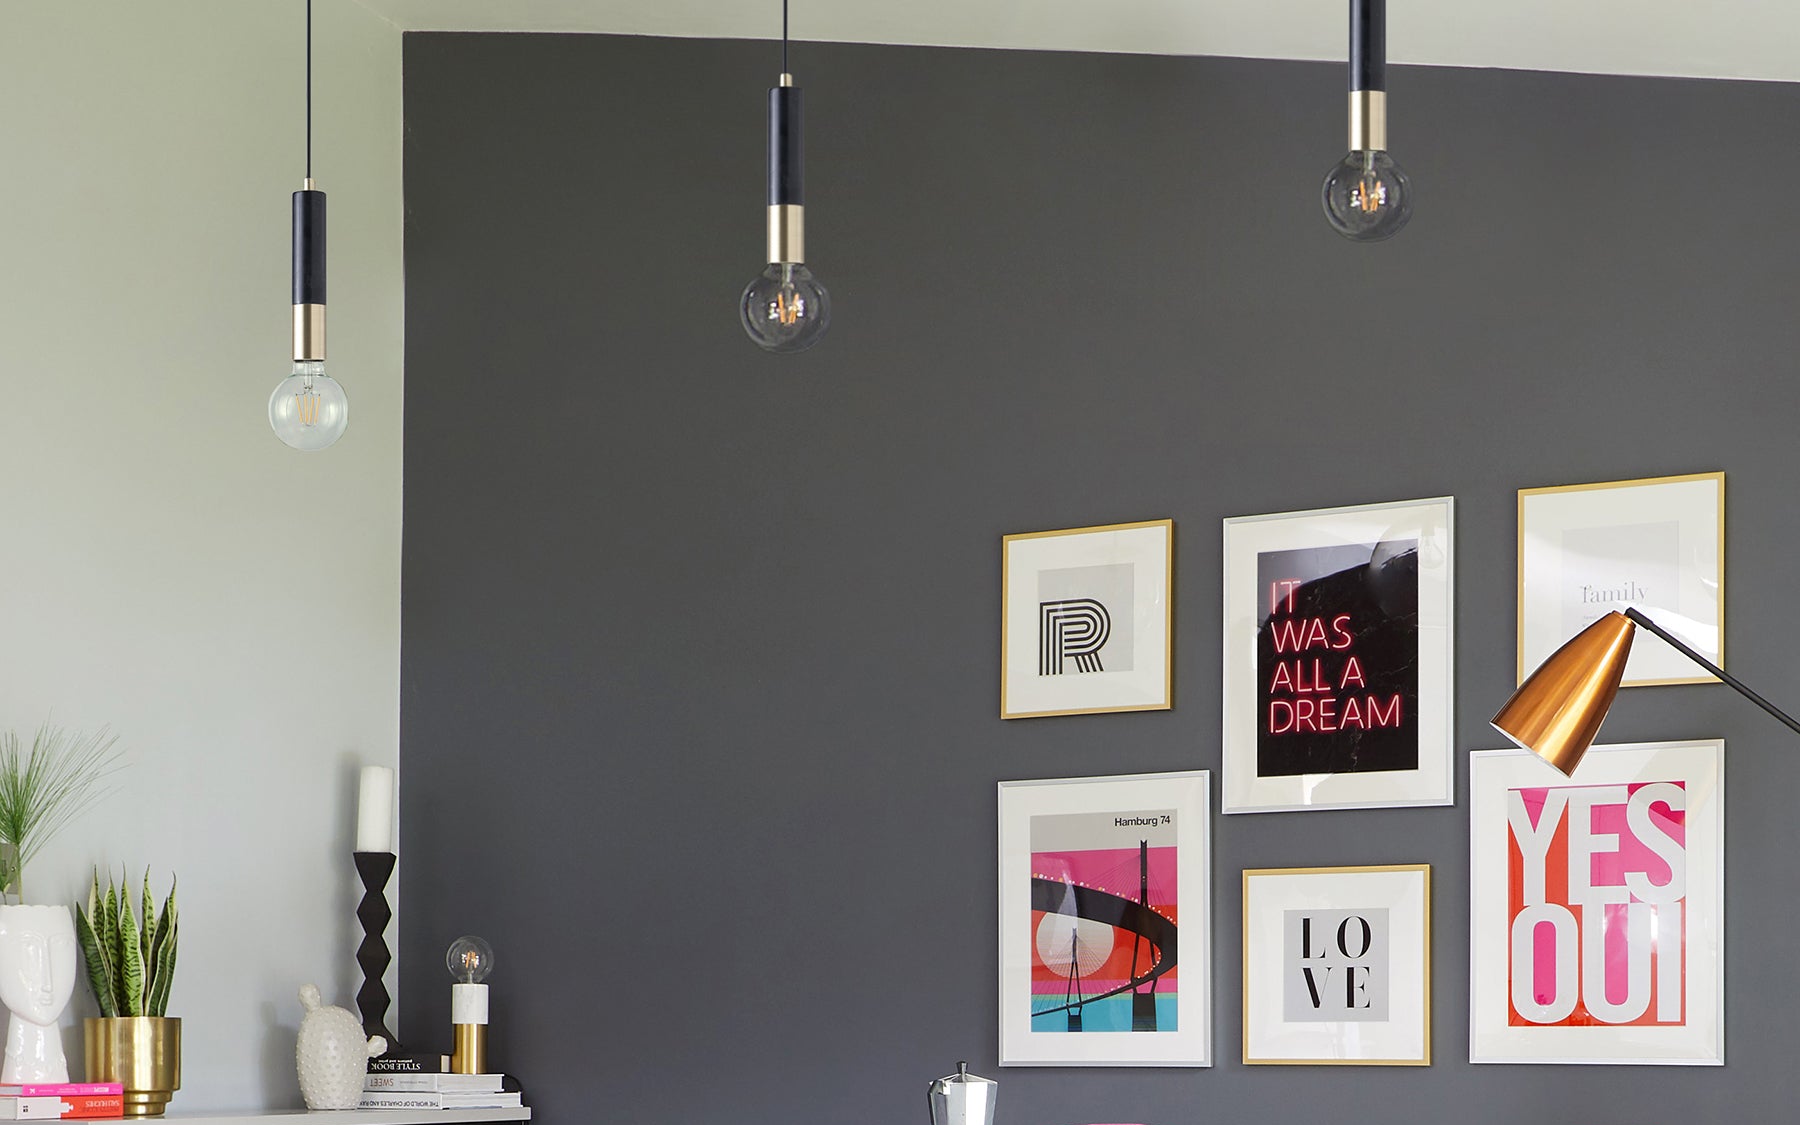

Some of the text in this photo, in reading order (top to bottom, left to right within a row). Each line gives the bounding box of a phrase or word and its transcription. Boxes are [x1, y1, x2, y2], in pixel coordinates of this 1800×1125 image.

[1271, 580, 1301, 615] IT
[1581, 580, 1649, 605] family
[1040, 598, 1110, 676] R
[1270, 616, 1351, 653] WAS
[1270, 656, 1365, 694] ALL A
[1270, 694, 1400, 734] DREAM
[1114, 815, 1171, 828] Hamburg 74
[1507, 782, 1686, 905] YES
[1300, 915, 1372, 959] LO
[1511, 902, 1682, 1024] OUI
[1300, 966, 1371, 1009] VE
[369, 1078, 394, 1087] SWEET
[371, 1063, 421, 1071] STYLE BOOK
